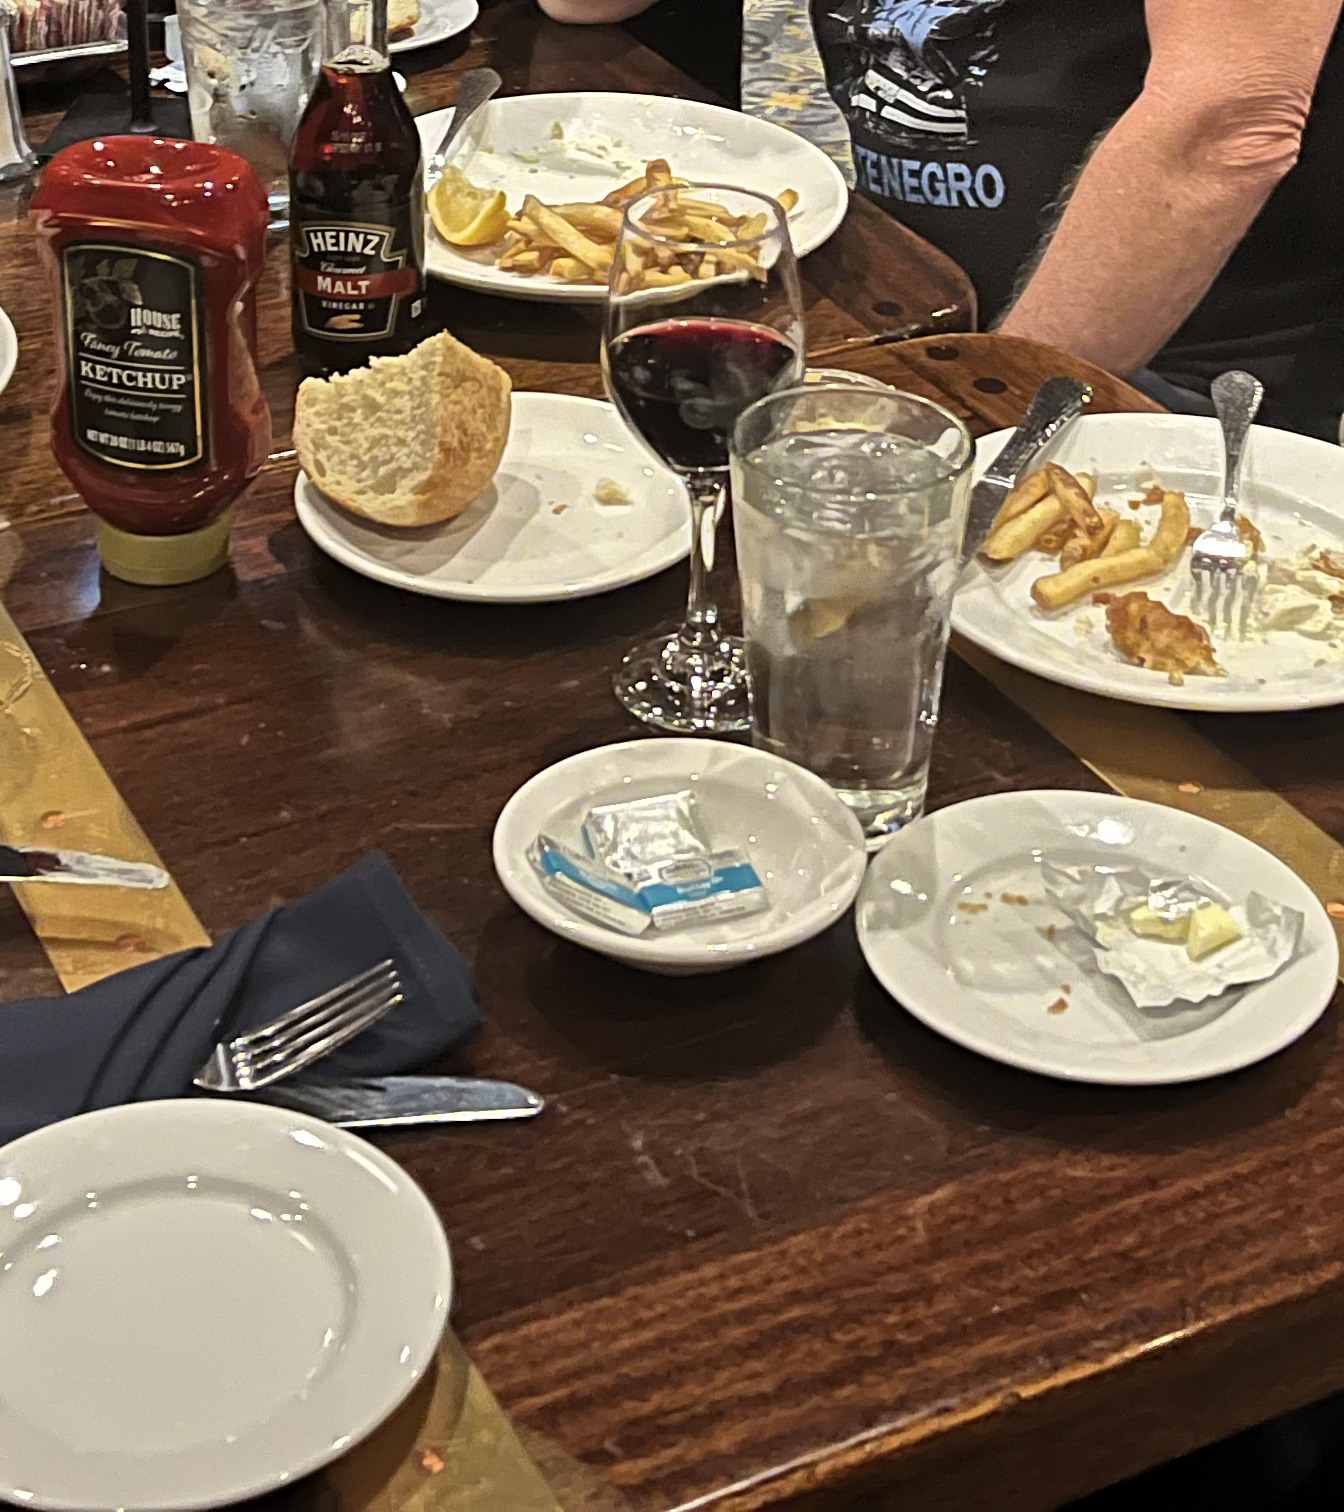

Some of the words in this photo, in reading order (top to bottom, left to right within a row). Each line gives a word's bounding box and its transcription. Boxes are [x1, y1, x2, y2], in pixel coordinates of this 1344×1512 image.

[309, 231, 380, 255] HEINZ
[317, 276, 370, 295] MALT
[321, 300, 365, 310] VINEGAR
[130, 307, 181, 330] HOUSE
[80, 332, 121, 359] Fancy
[123, 340, 178, 360] Tomato
[80, 360, 186, 390] KETCHUP
